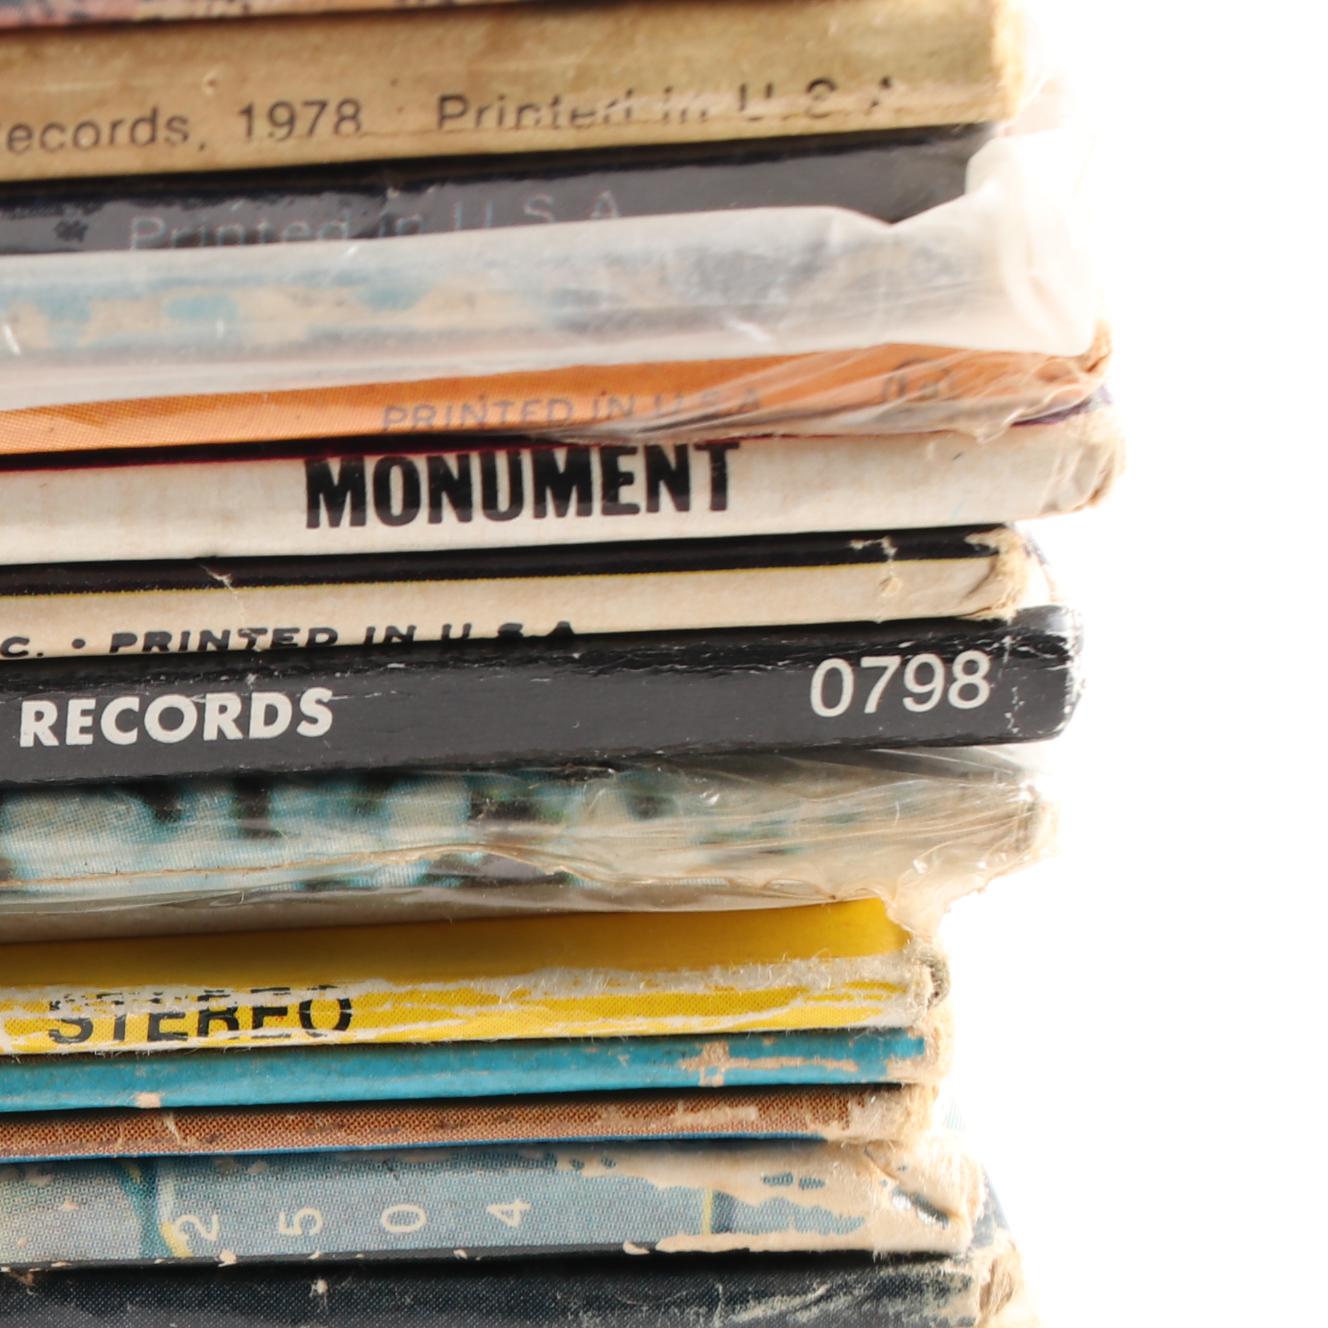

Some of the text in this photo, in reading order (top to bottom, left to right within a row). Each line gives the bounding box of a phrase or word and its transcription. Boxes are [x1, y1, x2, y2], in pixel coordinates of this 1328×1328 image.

[238, 99, 364, 141] 1978
[129, 213, 354, 252] Printed
[380, 391, 575, 434] PRINTED
[590, 387, 638, 423] IN
[306, 440, 742, 530] MONUMENT
[108, 624, 339, 655] PRINTED
[362, 625, 417, 645] IN
[809, 650, 992, 718] 0798
[18, 687, 336, 748] RECORDS
[48, 984, 353, 1046] STEREO
